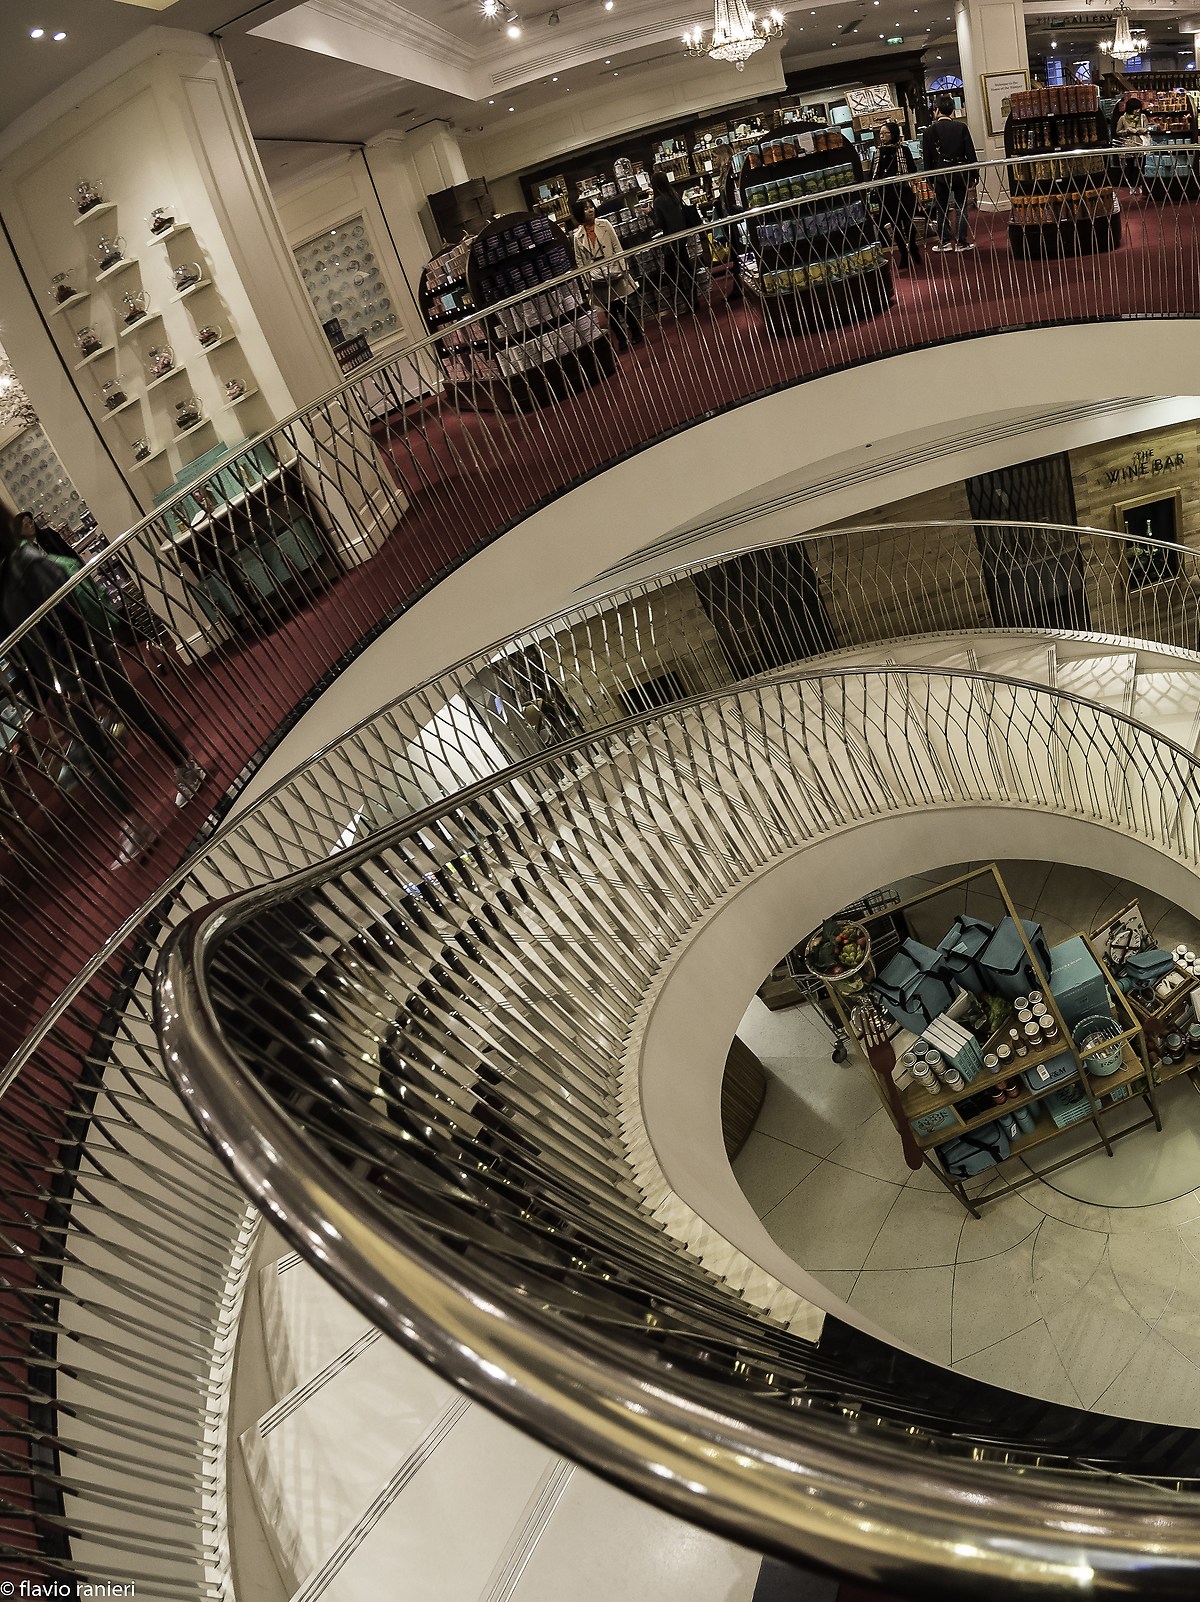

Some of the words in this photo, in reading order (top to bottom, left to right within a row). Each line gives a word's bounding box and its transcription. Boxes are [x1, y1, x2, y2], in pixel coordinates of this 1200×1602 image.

[1136, 449, 1155, 460] THE
[1105, 462, 1150, 484] WINE
[1155, 453, 1185, 472] BAR
